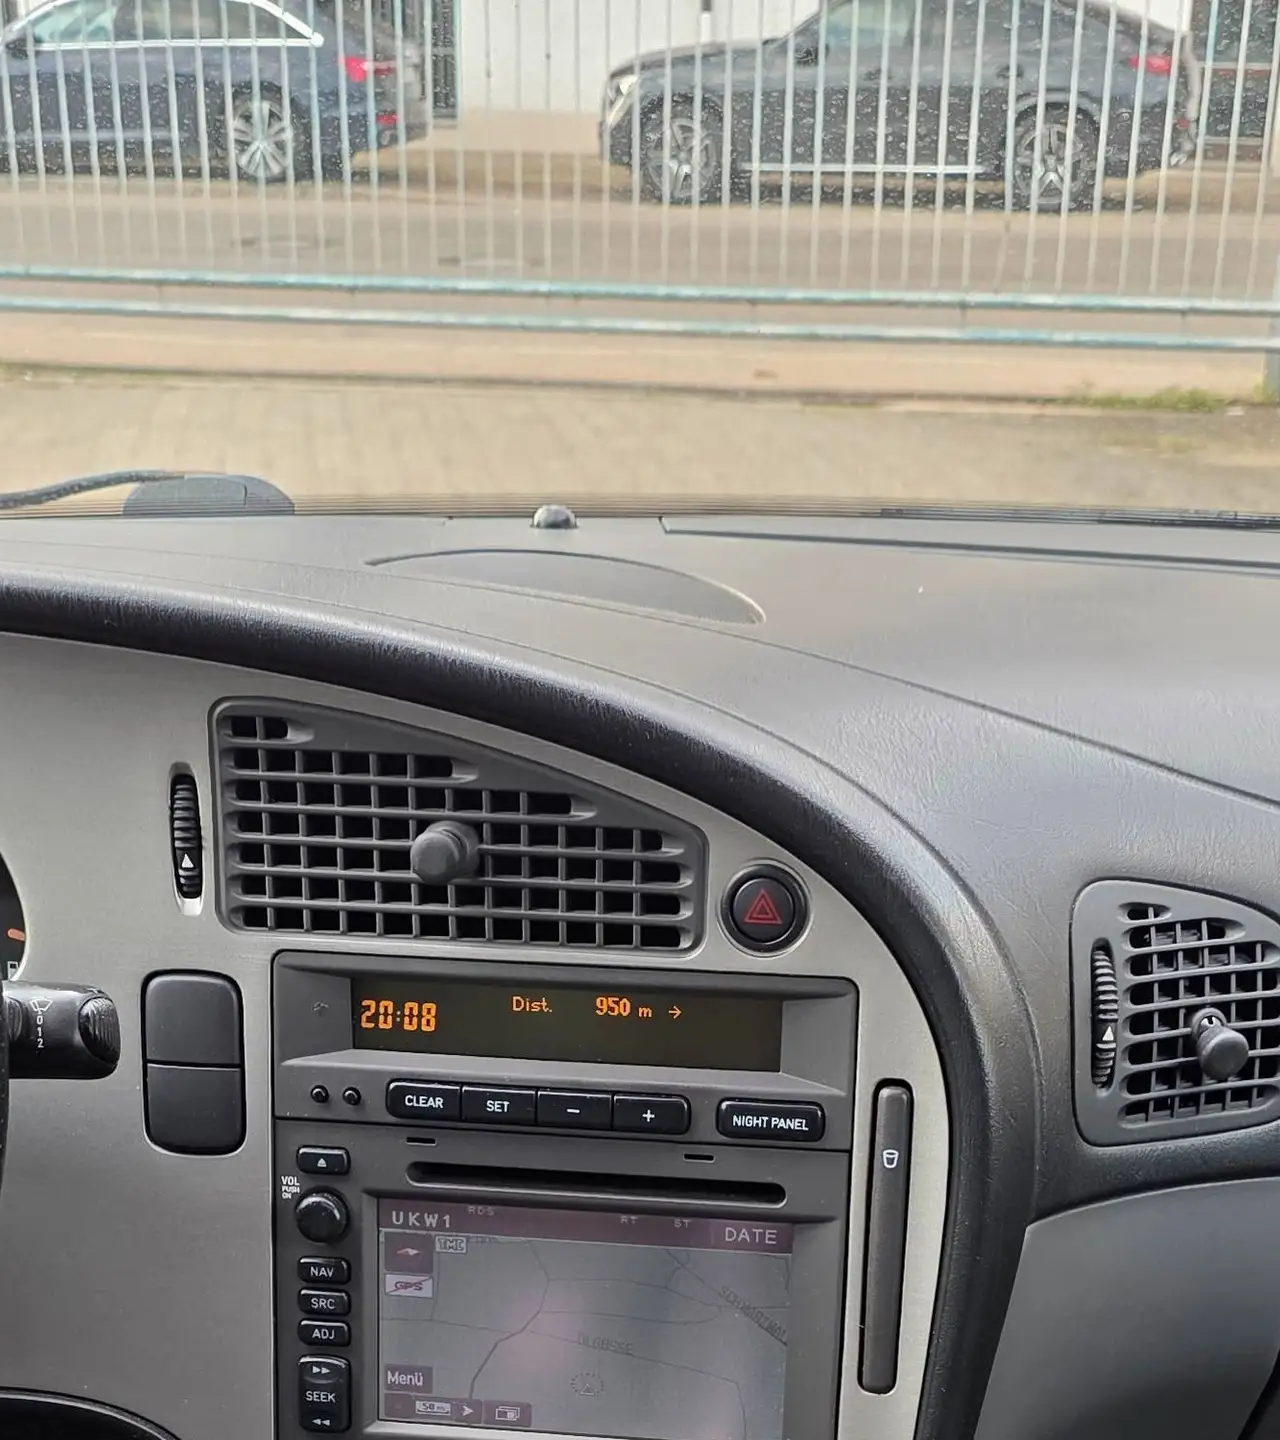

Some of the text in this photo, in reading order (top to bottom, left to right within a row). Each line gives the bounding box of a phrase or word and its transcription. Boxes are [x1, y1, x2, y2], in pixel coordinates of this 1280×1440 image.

[511, 996, 653, 1018] Dist. 950 m
[360, 999, 437, 1032] 20:08
[37, 1038, 44, 1048] 2
[404, 1095, 444, 1110] CLEAR
[486, 1100, 509, 1113] SET
[732, 1115, 810, 1132] NIGHT PANEL
[281, 1175, 300, 1186] VOL
[468, 1205, 495, 1216] RDS
[620, 1215, 638, 1225] RT
[724, 1226, 778, 1245] DATE
[310, 1266, 334, 1278] NAV
[394, 1281, 424, 1292] GPS
[310, 1298, 336, 1309] SRC
[311, 1328, 335, 1340] ADJ
[386, 1370, 424, 1387] Menü
[305, 1390, 336, 1403] SEEK
